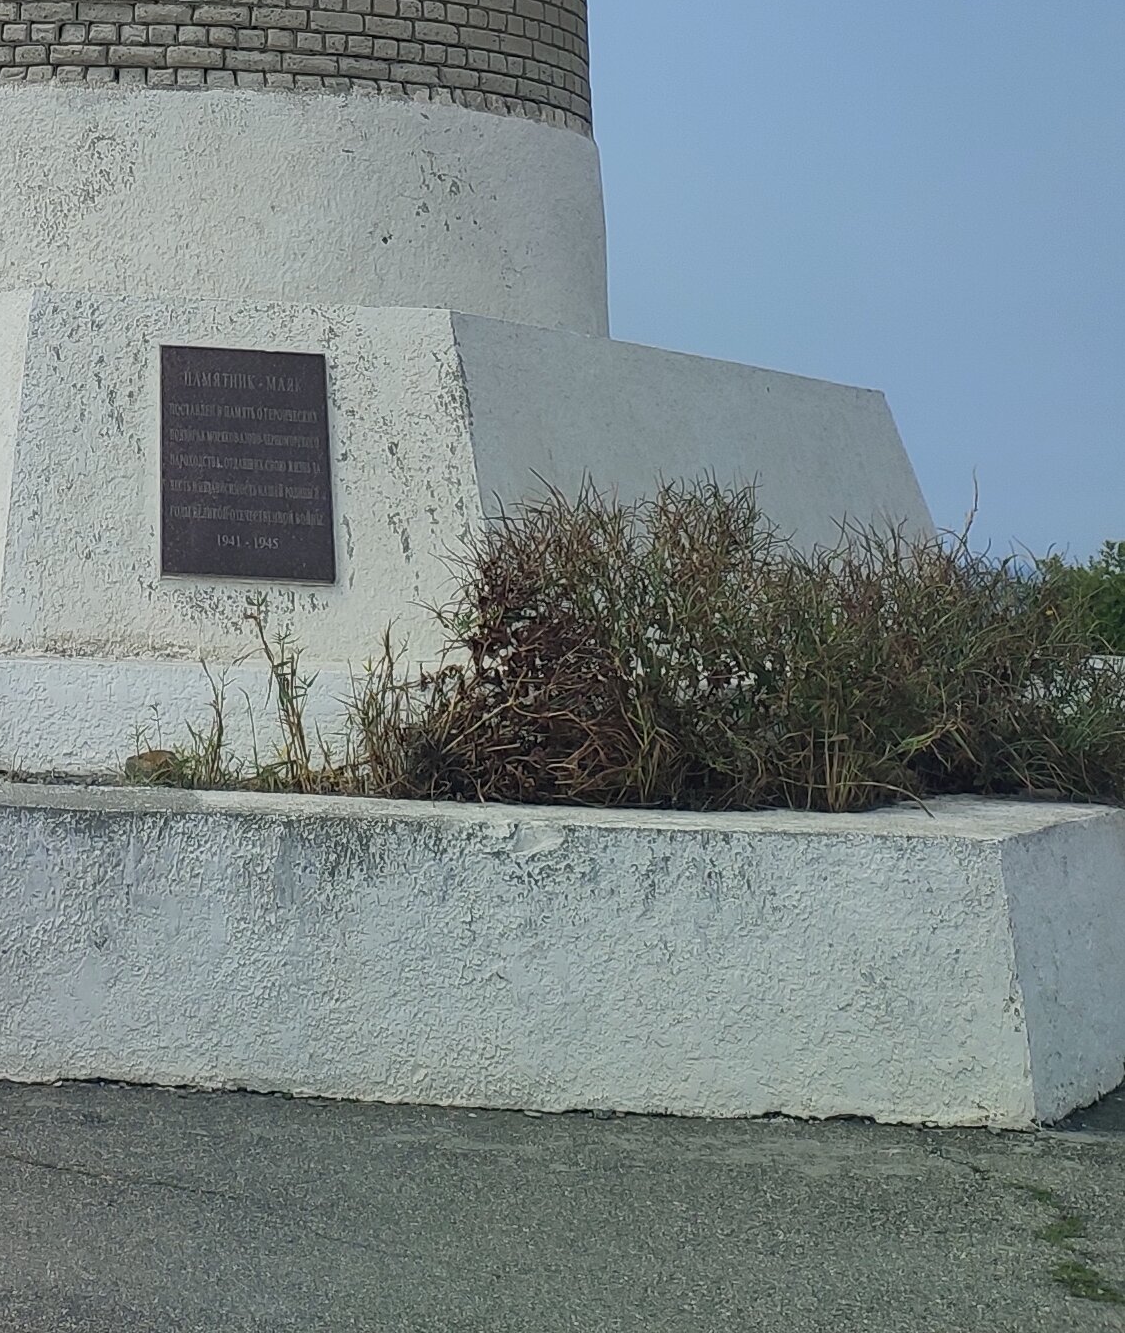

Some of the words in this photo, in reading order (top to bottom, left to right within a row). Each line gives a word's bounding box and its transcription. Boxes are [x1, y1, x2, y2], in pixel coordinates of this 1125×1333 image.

[184, 371, 256, 390] ПАМЯТНИК
[217, 534, 241, 548] 1941
[253, 536, 280, 550] 1945
